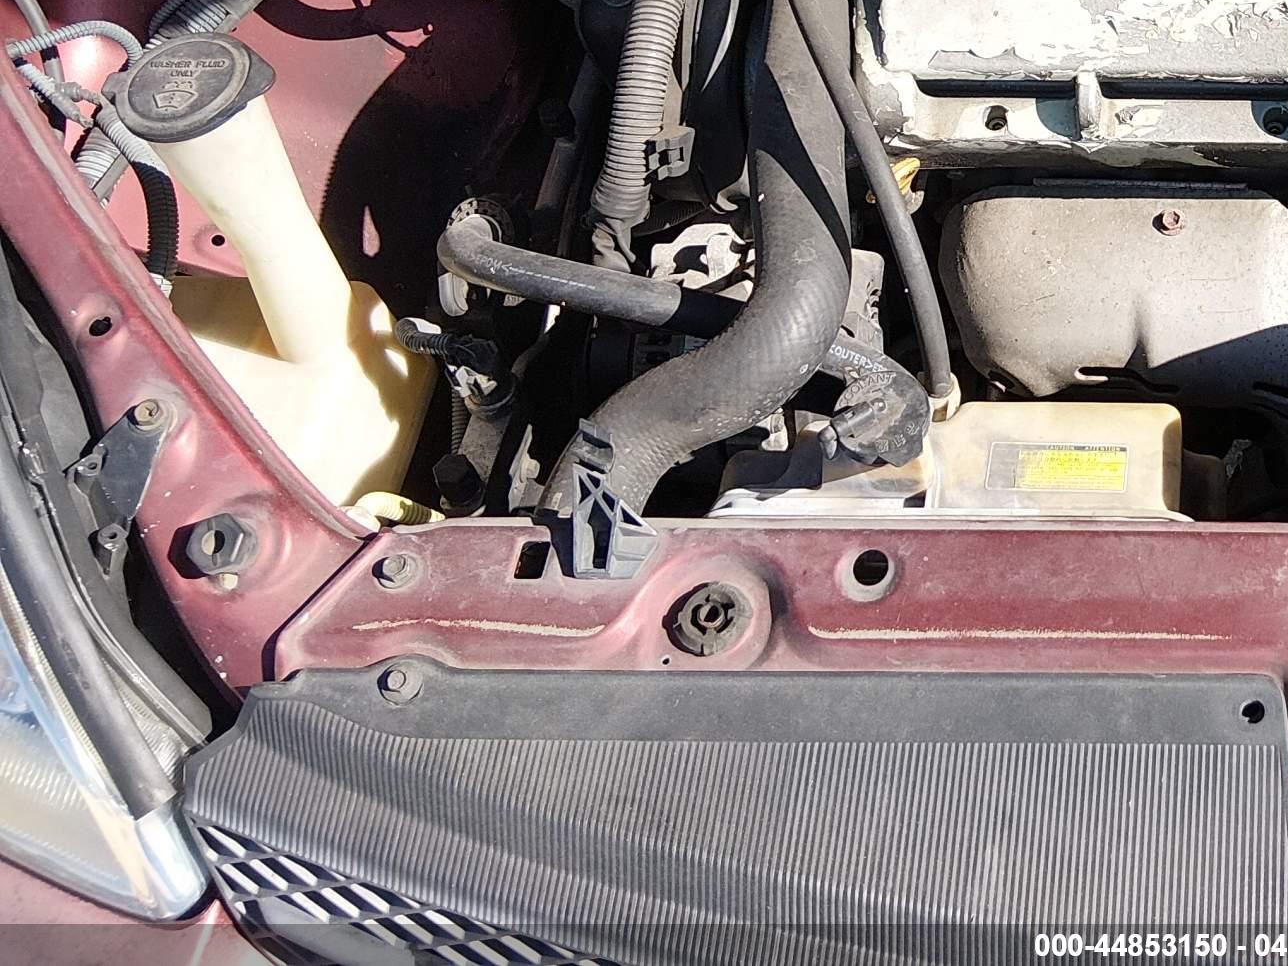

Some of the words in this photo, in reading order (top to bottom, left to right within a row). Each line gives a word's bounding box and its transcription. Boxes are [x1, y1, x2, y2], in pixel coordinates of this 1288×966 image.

[150, 60, 192, 69] WASHER
[195, 59, 226, 68] FLUID
[170, 69, 193, 78] ONLY
